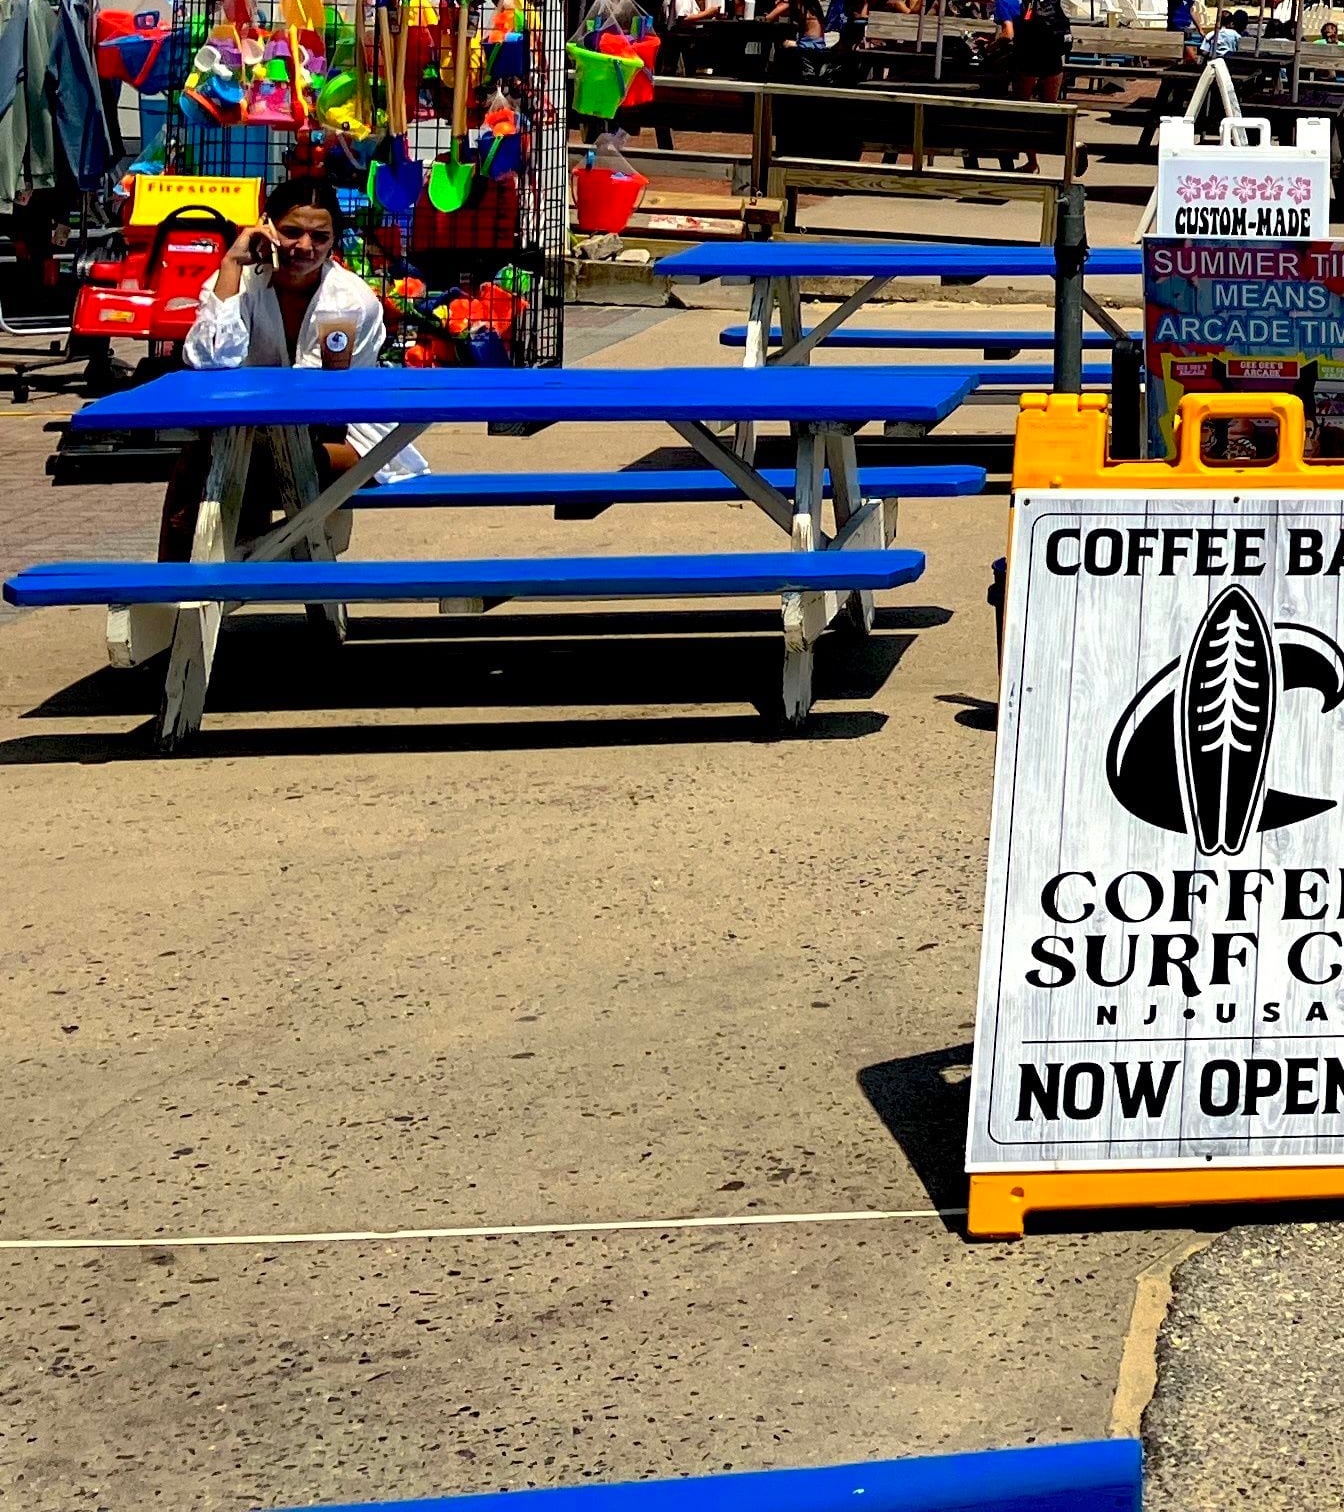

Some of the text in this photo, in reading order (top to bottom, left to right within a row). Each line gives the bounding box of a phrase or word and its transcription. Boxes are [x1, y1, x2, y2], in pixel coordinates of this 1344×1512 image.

[147, 182, 242, 194] Firestone
[1175, 207, 1311, 237] CUSTOM-MADE
[1154, 249, 1299, 277] SUMMER
[1215, 285, 1327, 309] MEANS
[1156, 318, 1291, 344] ARCADE
[1243, 369, 1281, 377] ARCADE
[1046, 528, 1267, 577] COFFEE
[1025, 932, 1259, 998] SURF
[1014, 1060, 1182, 1122] NOW
